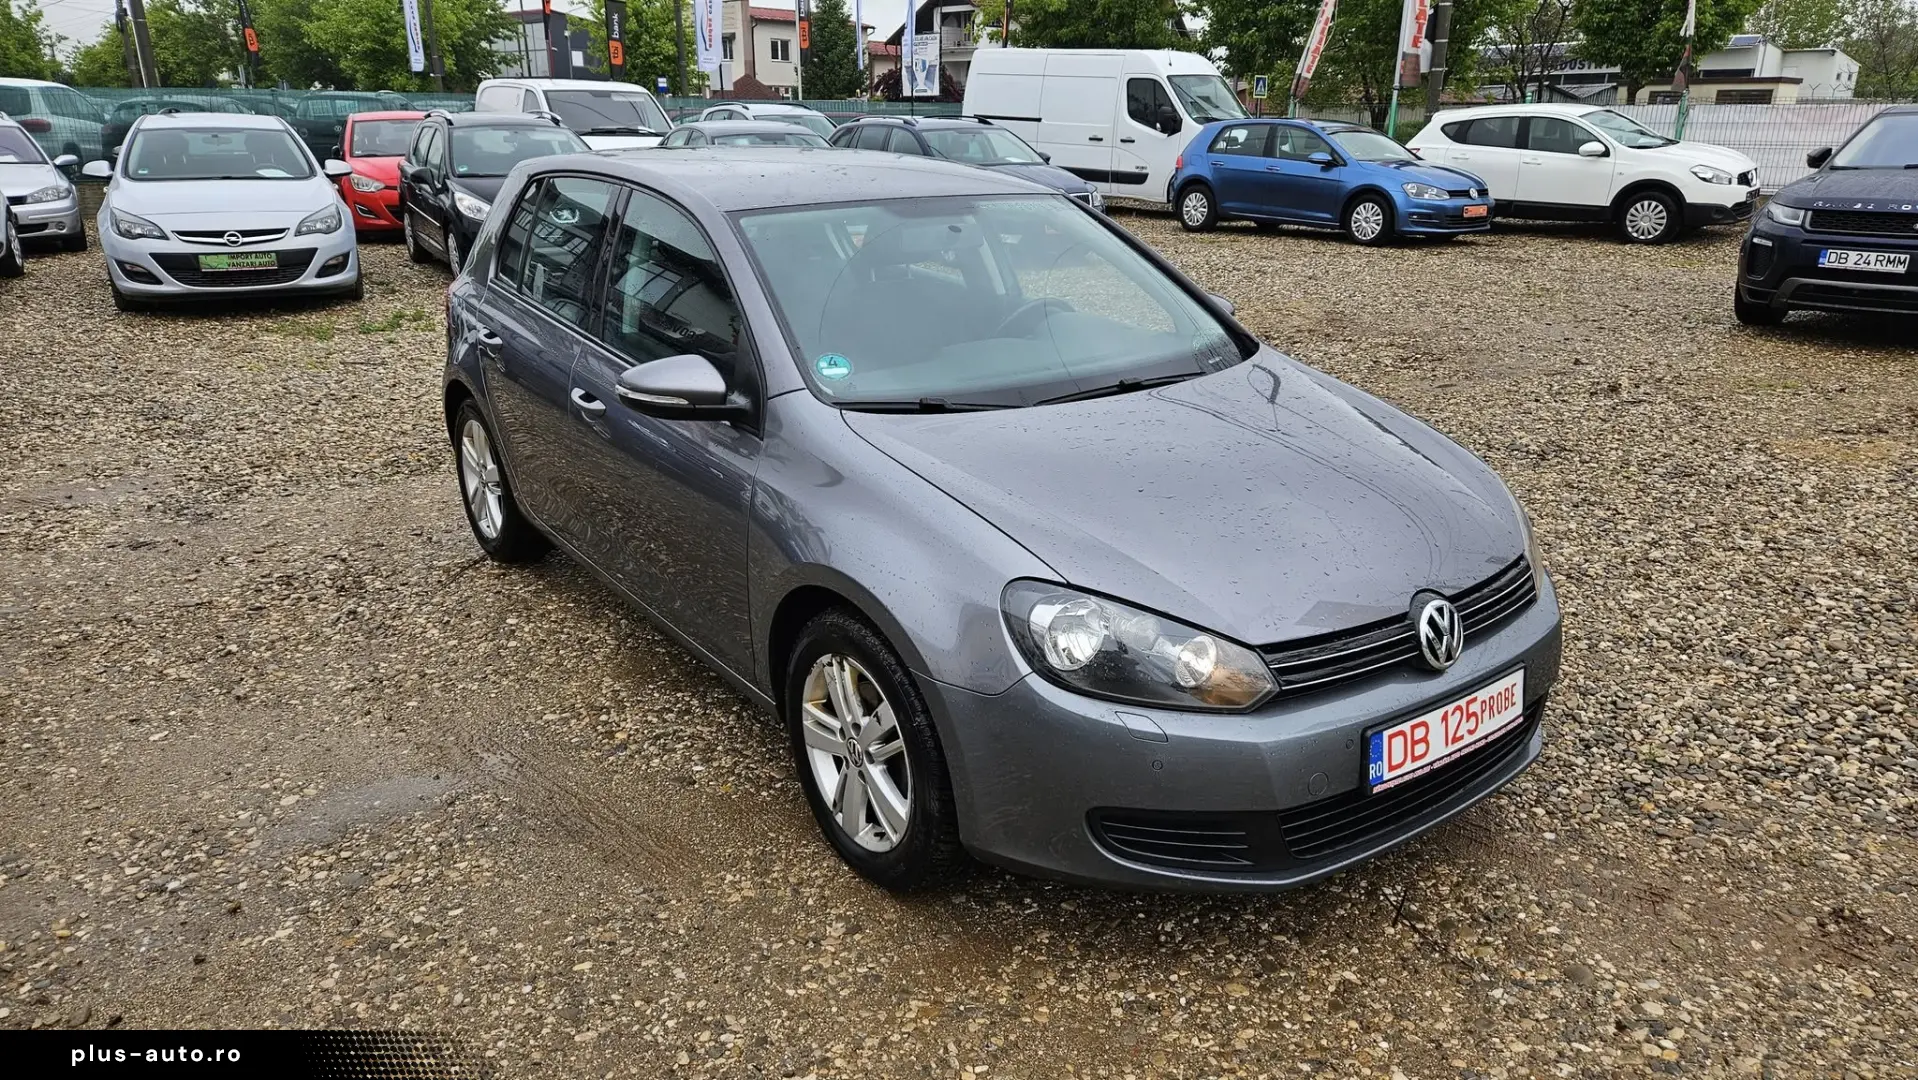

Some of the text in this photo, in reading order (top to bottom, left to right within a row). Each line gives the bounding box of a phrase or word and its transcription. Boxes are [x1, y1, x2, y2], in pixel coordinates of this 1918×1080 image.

[1827, 251, 1850, 264] DB
[1853, 253, 1871, 266] 24
[1873, 254, 1908, 269] RMM
[828, 356, 838, 367] 4
[1387, 720, 1430, 773] DB
[1440, 695, 1480, 749] 125
[1480, 682, 1517, 725] PROBE
[1369, 761, 1383, 780] RO
